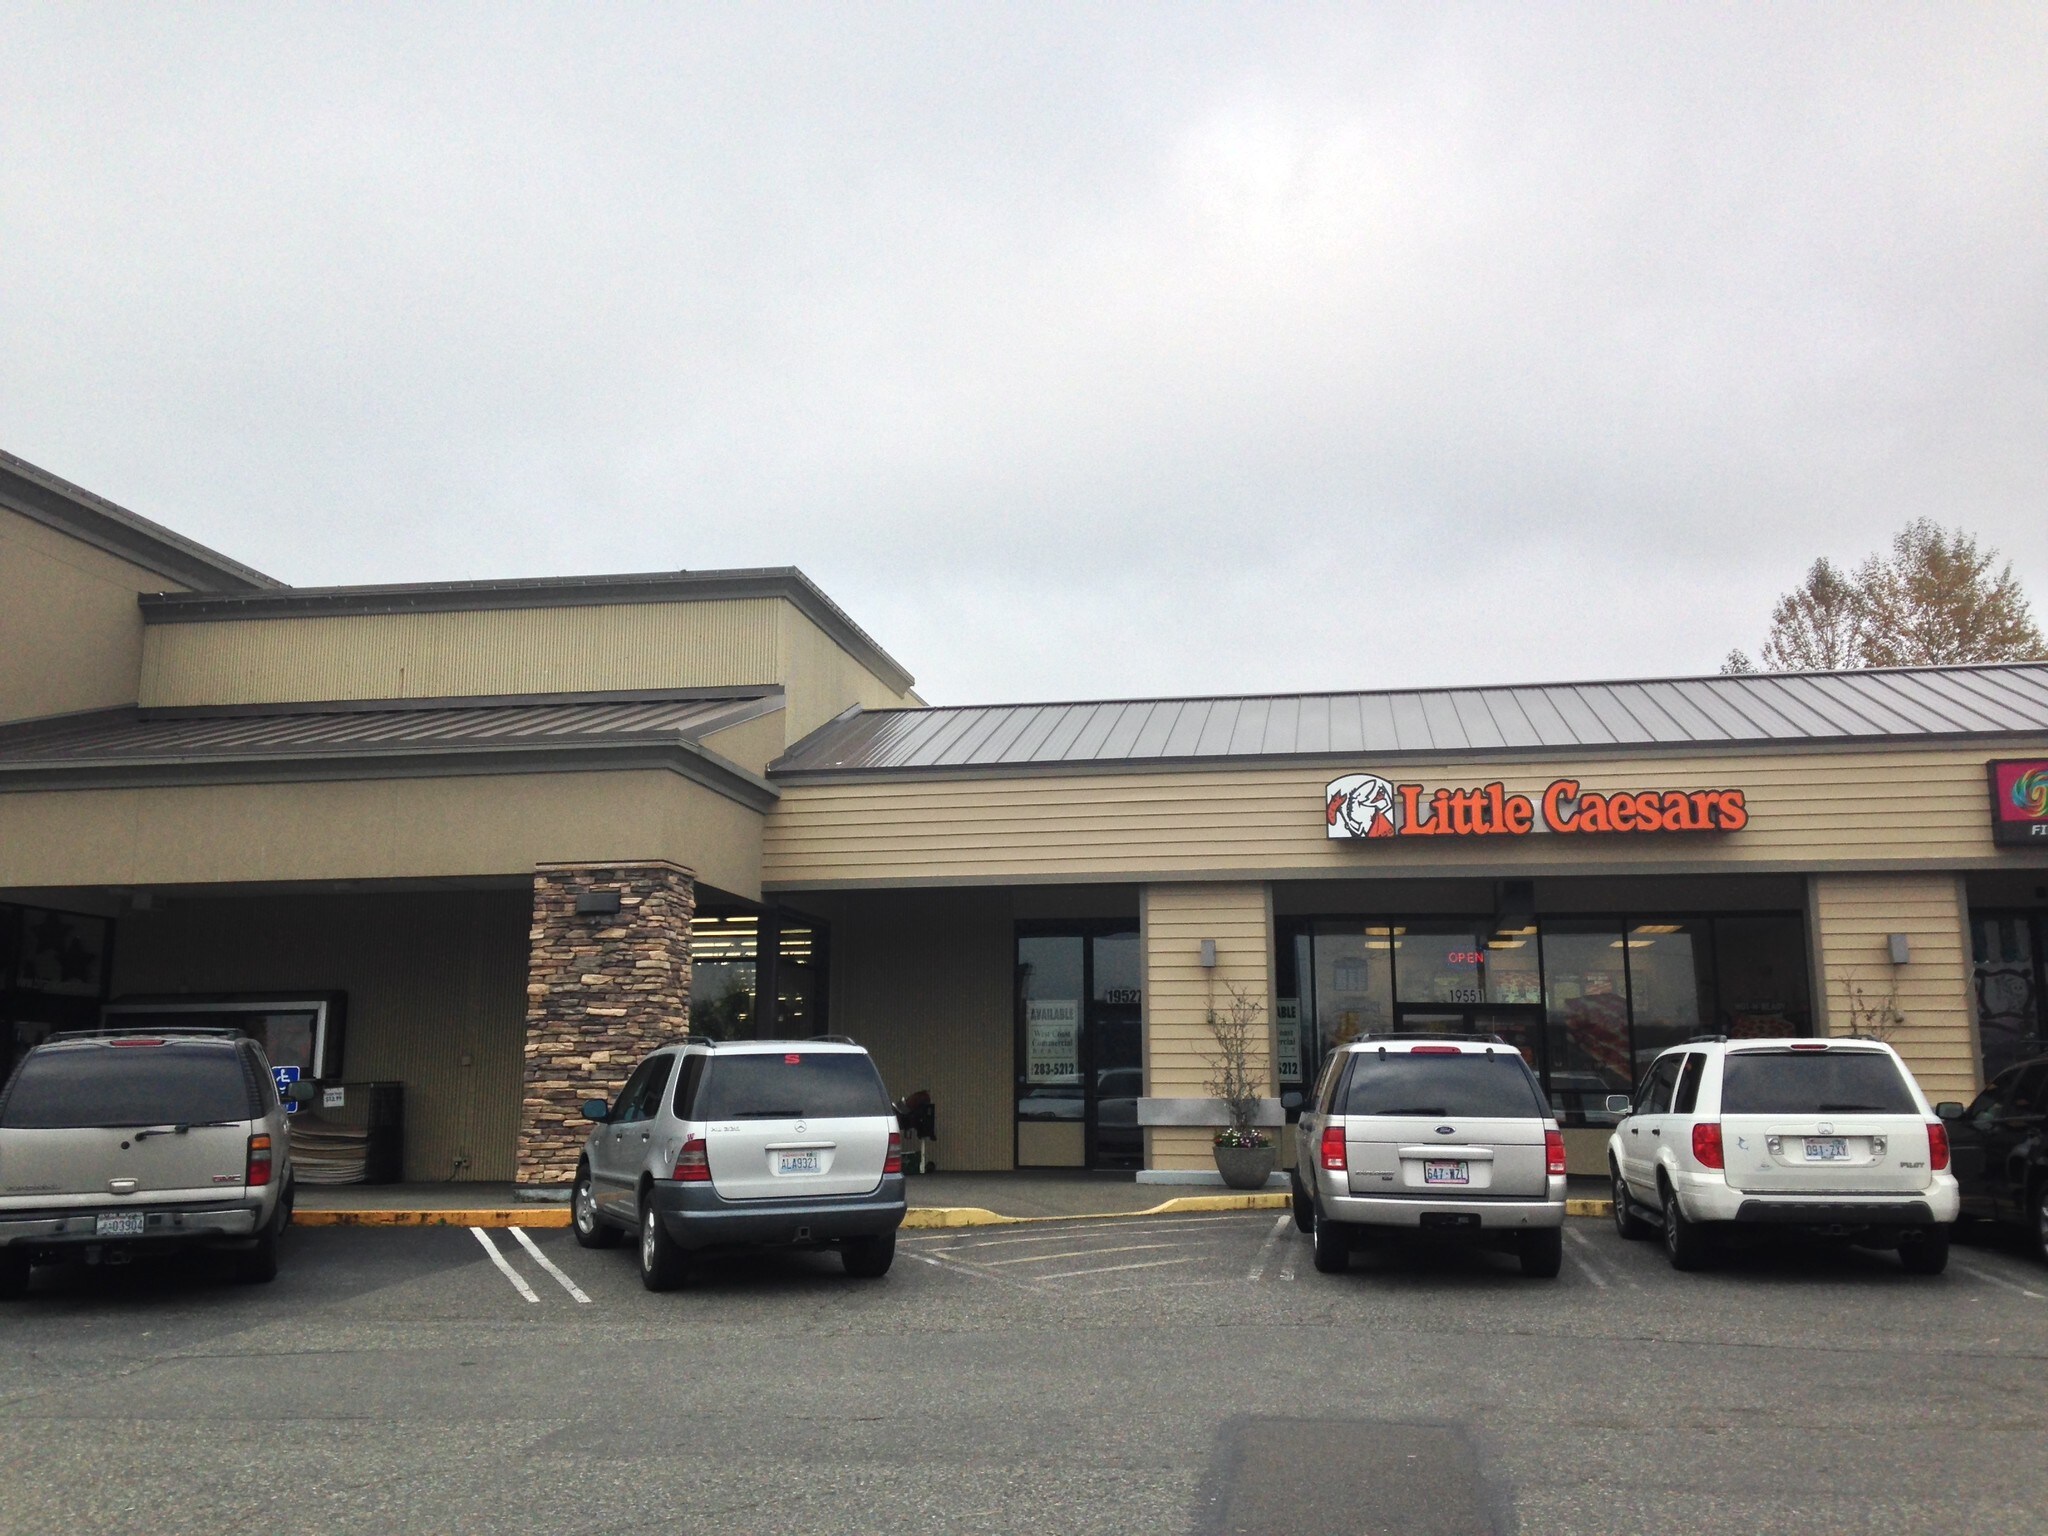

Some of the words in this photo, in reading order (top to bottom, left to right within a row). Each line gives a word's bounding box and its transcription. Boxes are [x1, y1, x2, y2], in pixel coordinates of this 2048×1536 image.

[1400, 782, 1533, 836] Little
[1542, 779, 1749, 835] Caesars
[1448, 952, 1484, 963] OPEN
[1450, 989, 1483, 1002] 19551
[1030, 1007, 1074, 1020] AVAILABLE
[1032, 1039, 1073, 1047] Commercial
[1034, 1063, 1075, 1075] 283-5212
[781, 1157, 818, 1170] ALA9321
[212, 1174, 241, 1183] GMC
